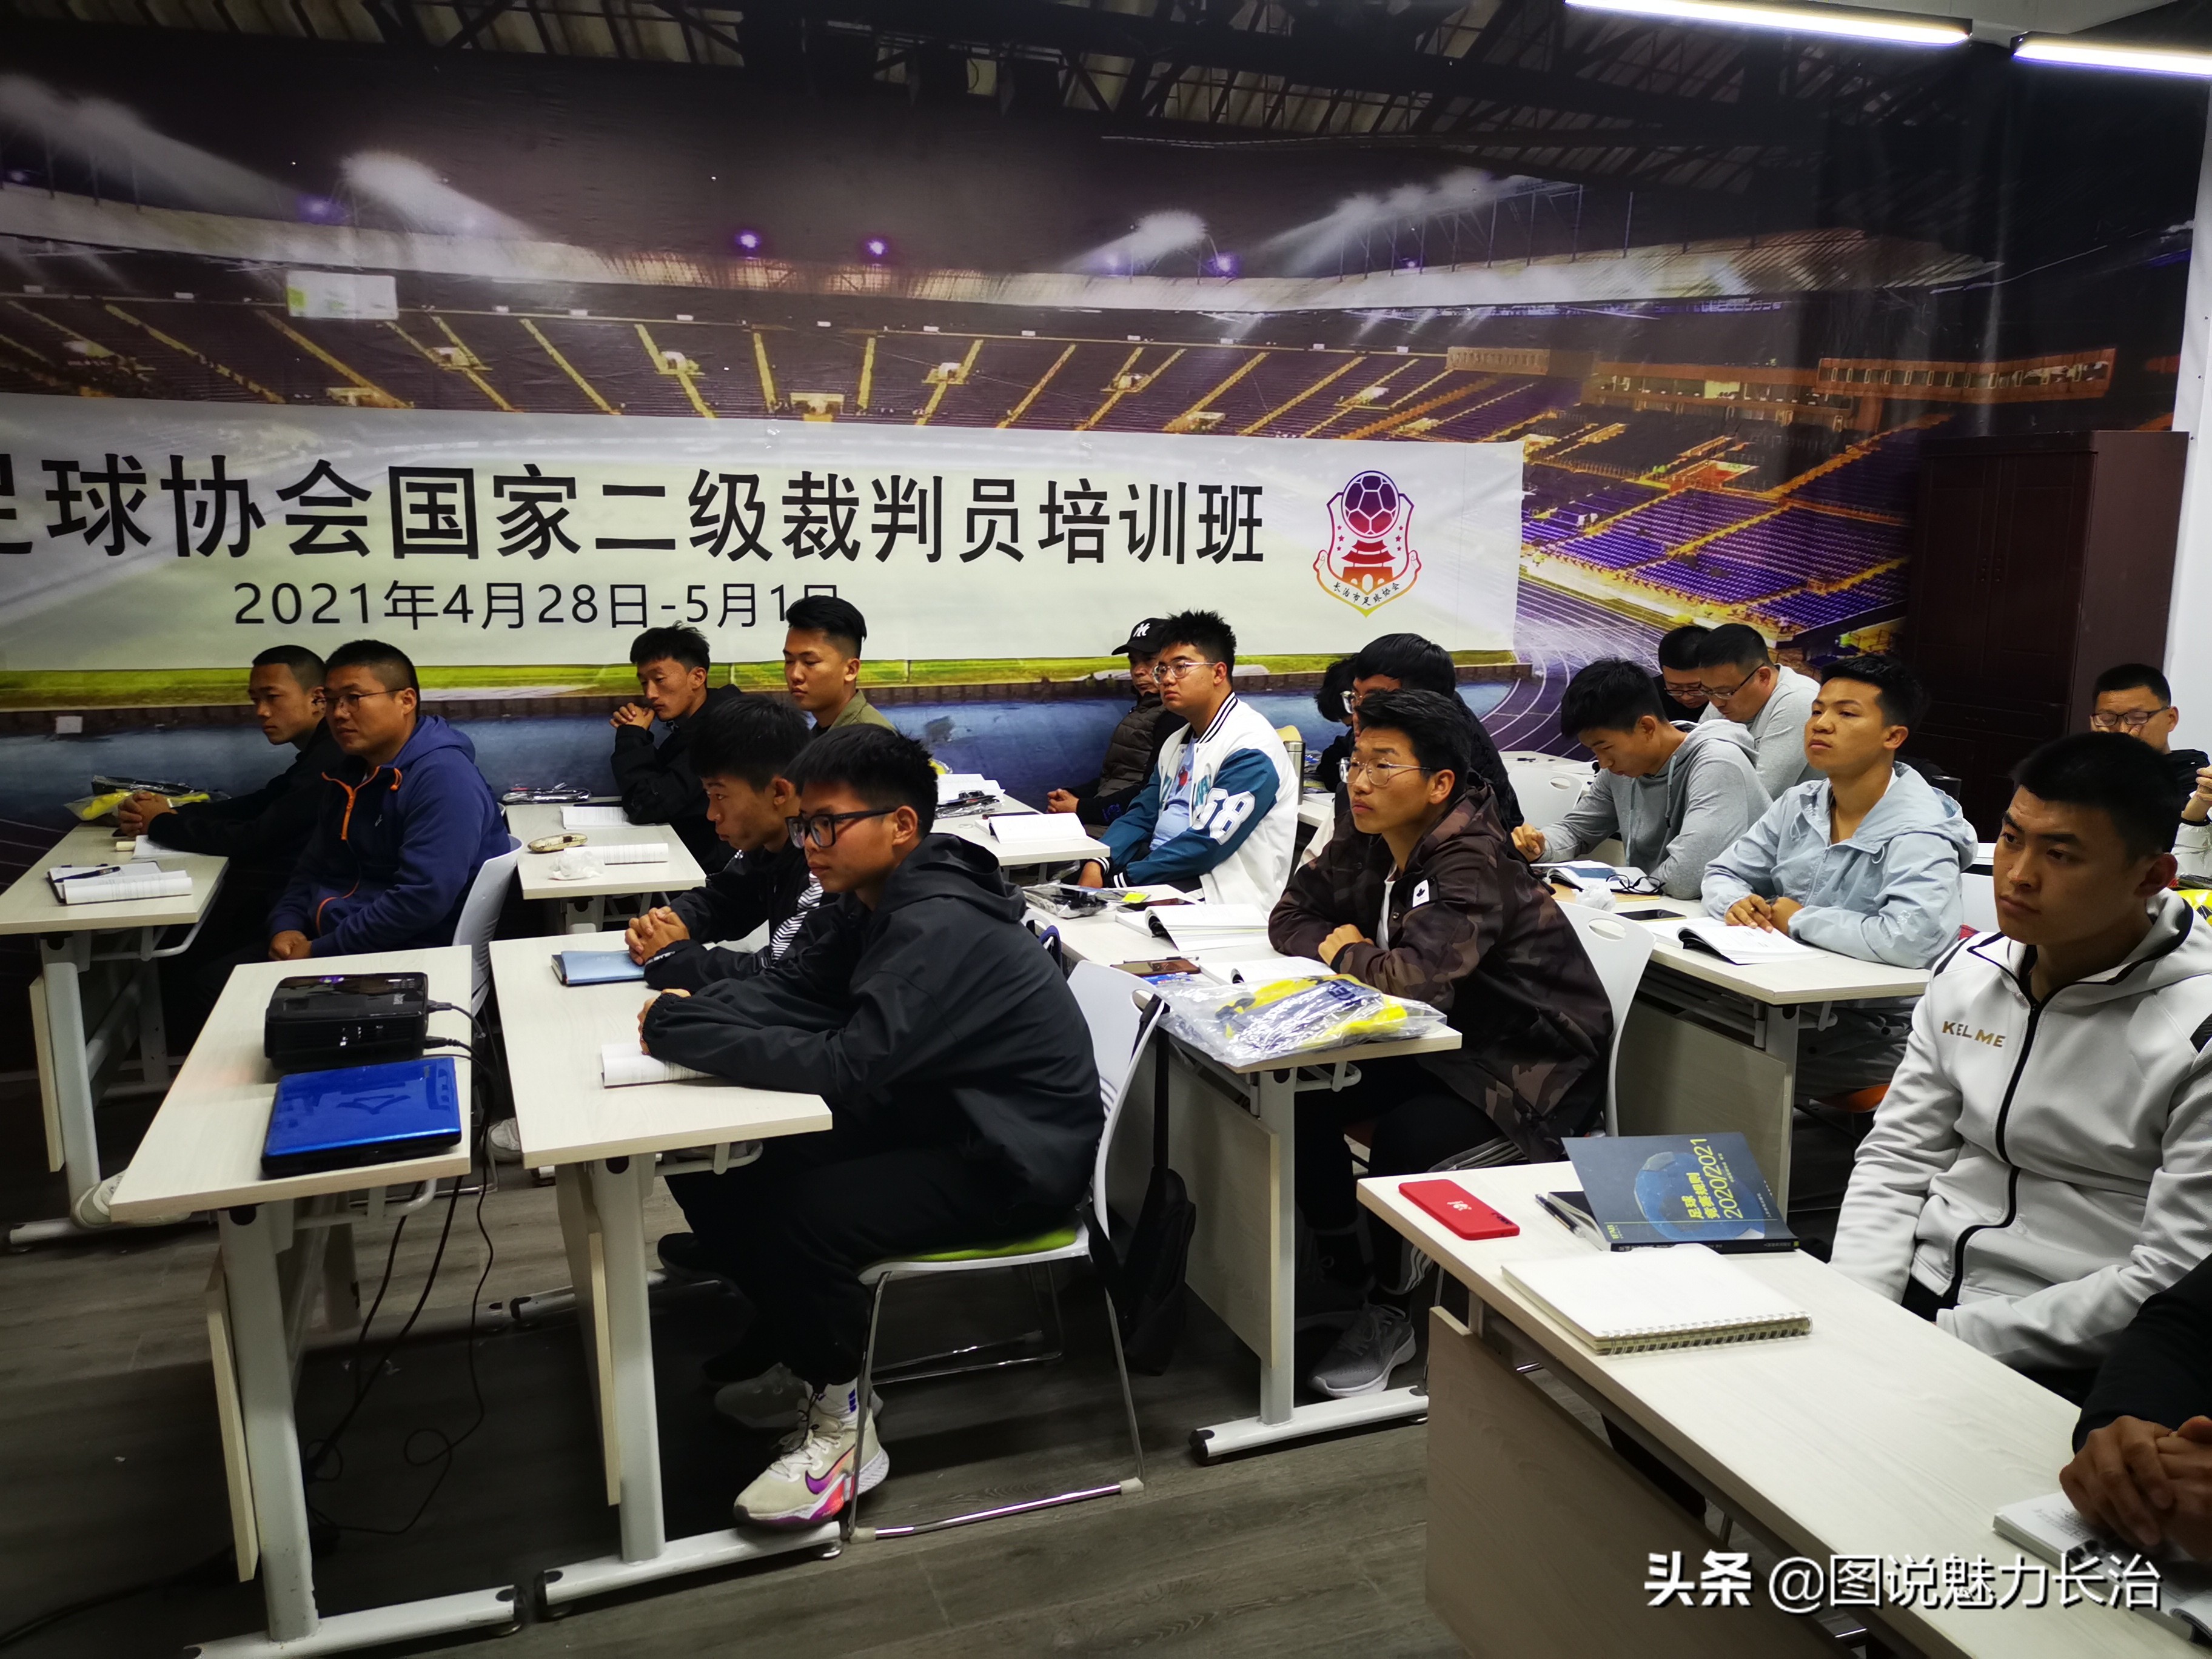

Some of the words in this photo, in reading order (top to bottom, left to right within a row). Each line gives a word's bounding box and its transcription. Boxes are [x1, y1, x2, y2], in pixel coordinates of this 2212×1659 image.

[235, 580, 838, 630] 2021年4月28日-5月1
[1942, 1021, 2006, 1048] KELME
[1690, 1139, 1743, 1219] 2020/2021
[1681, 1195, 1704, 1219] 足球
